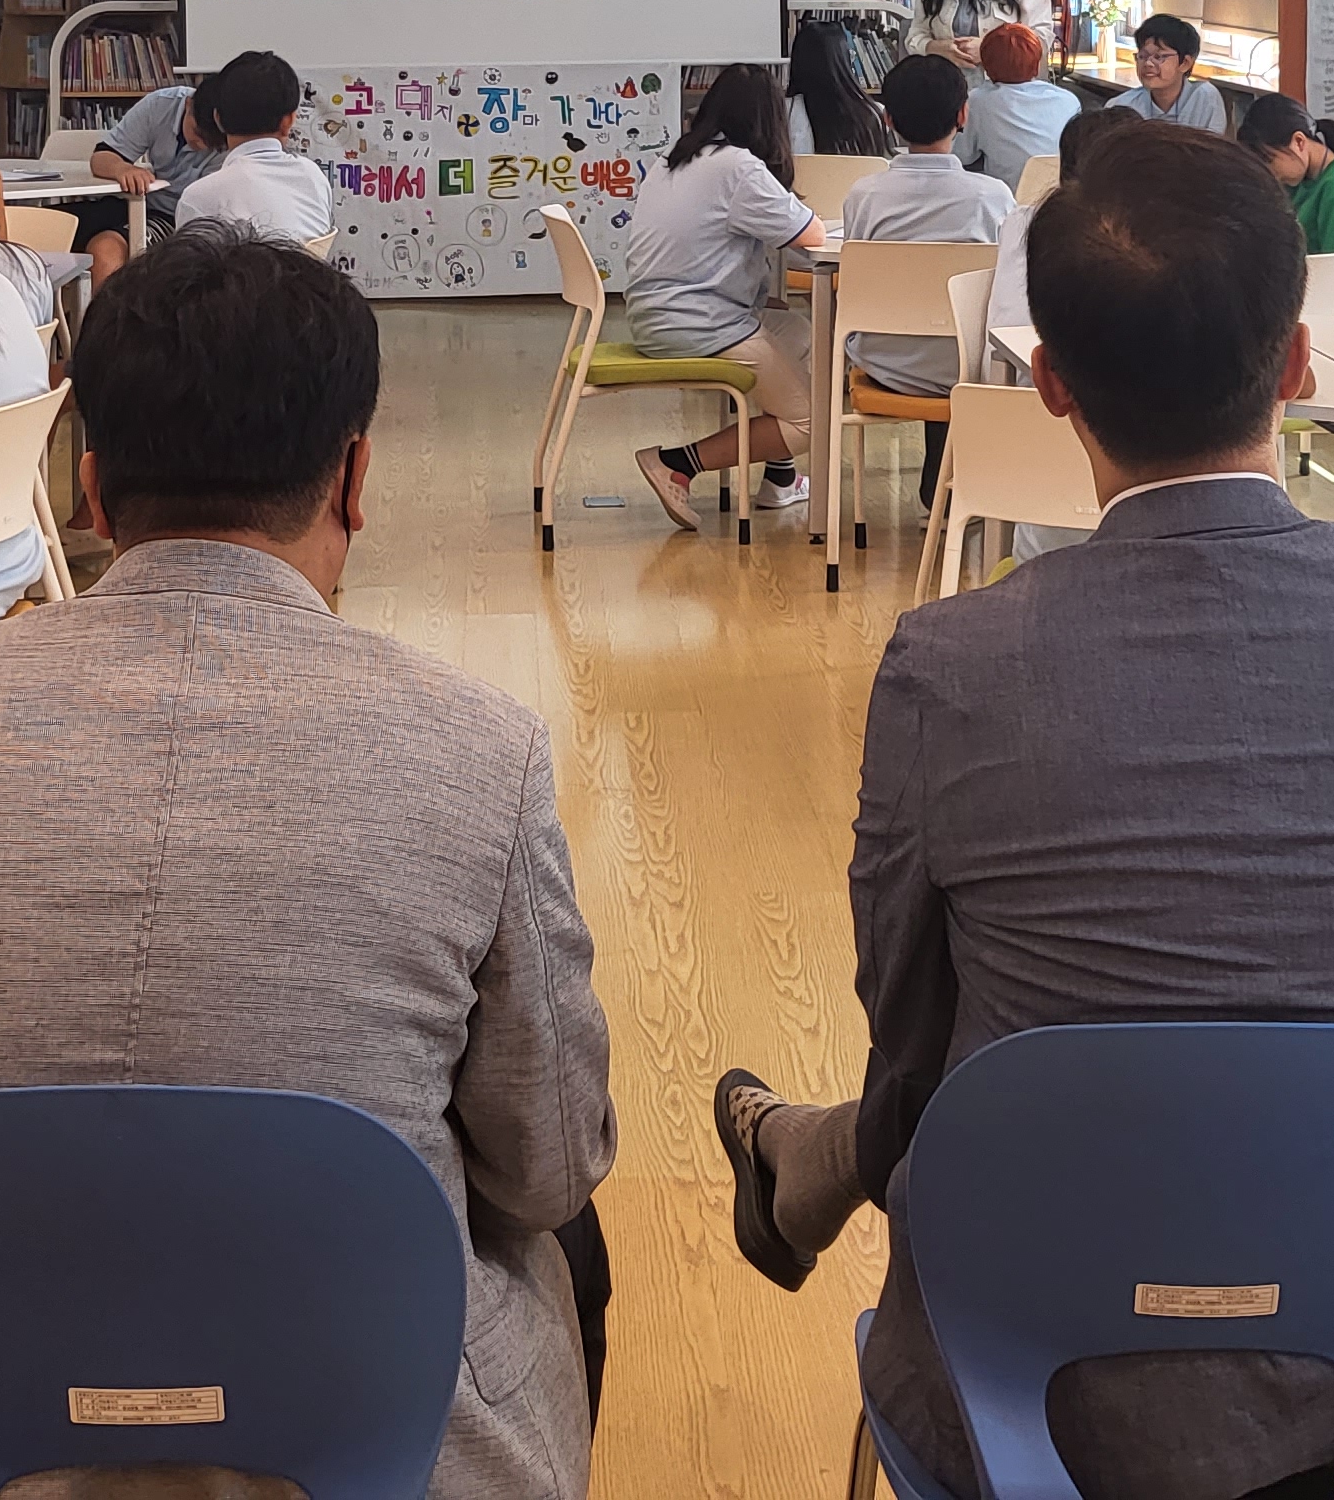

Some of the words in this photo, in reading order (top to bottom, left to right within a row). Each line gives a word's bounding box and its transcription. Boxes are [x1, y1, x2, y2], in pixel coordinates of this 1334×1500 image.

[550, 95, 575, 126] 가
[439, 158, 474, 197] 더
[488, 154, 579, 200] 즐거운
